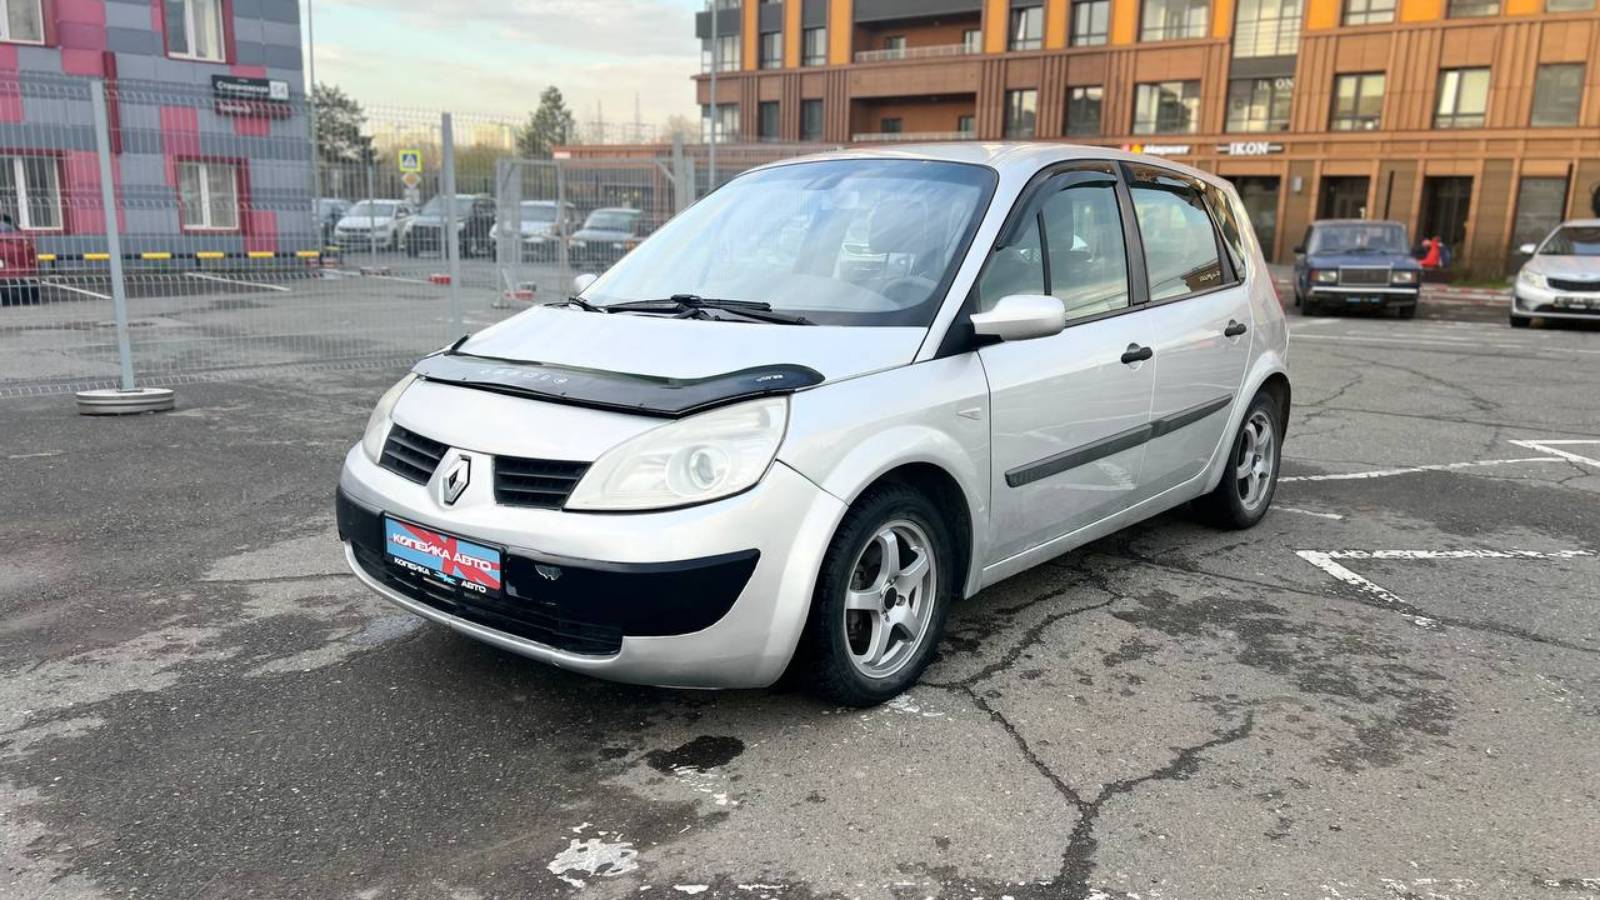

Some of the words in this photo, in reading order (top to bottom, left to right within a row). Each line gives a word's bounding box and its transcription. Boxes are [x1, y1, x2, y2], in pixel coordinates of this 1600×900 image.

[1229, 142, 1270, 156] IKON
[393, 533, 451, 560] КОПЕЙКА
[453, 553, 491, 571] АВТО
[461, 580, 487, 593] АВТО
